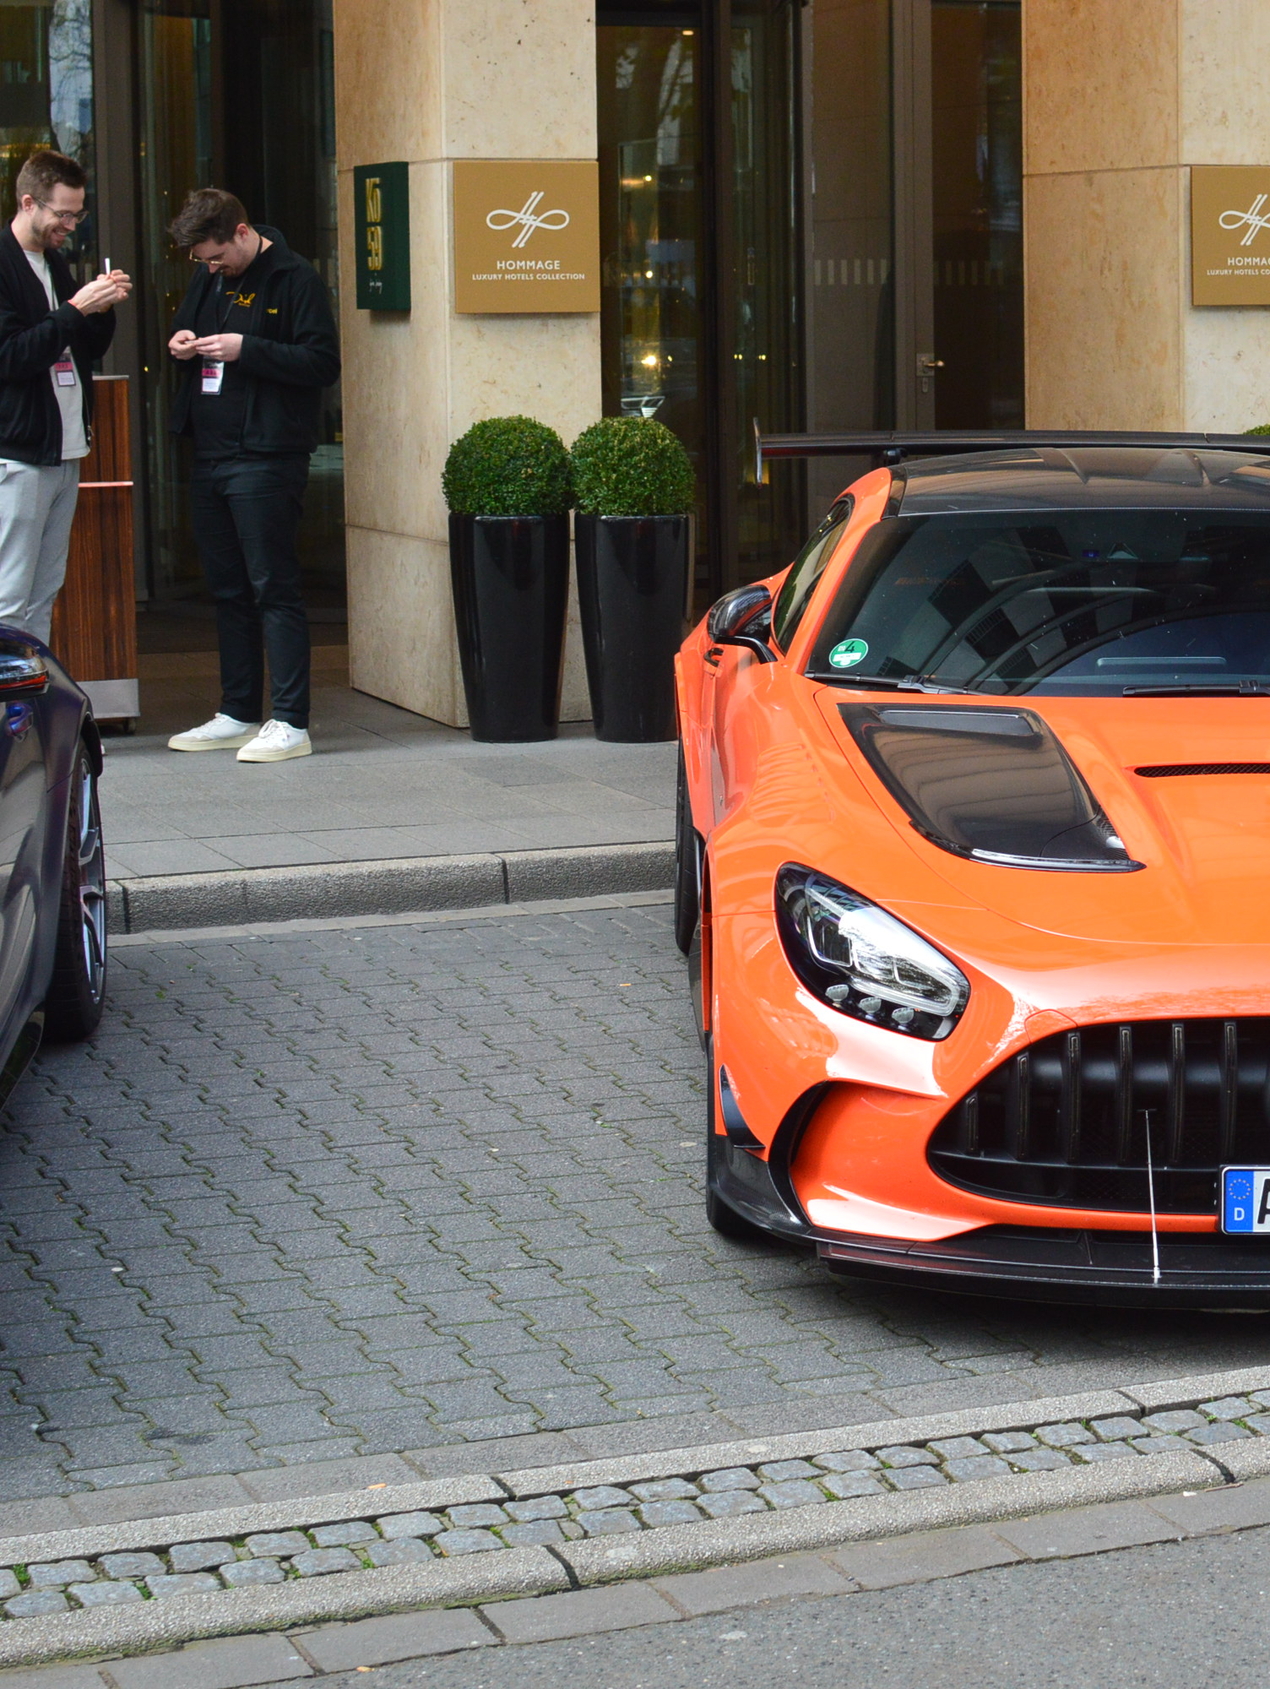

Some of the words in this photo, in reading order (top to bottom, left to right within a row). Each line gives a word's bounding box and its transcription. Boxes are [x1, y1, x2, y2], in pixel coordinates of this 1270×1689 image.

[366, 226, 382, 270] 59
[496, 260, 560, 270] HOMMAGE
[845, 641, 855, 653] 4
[1234, 1207, 1245, 1221] D
